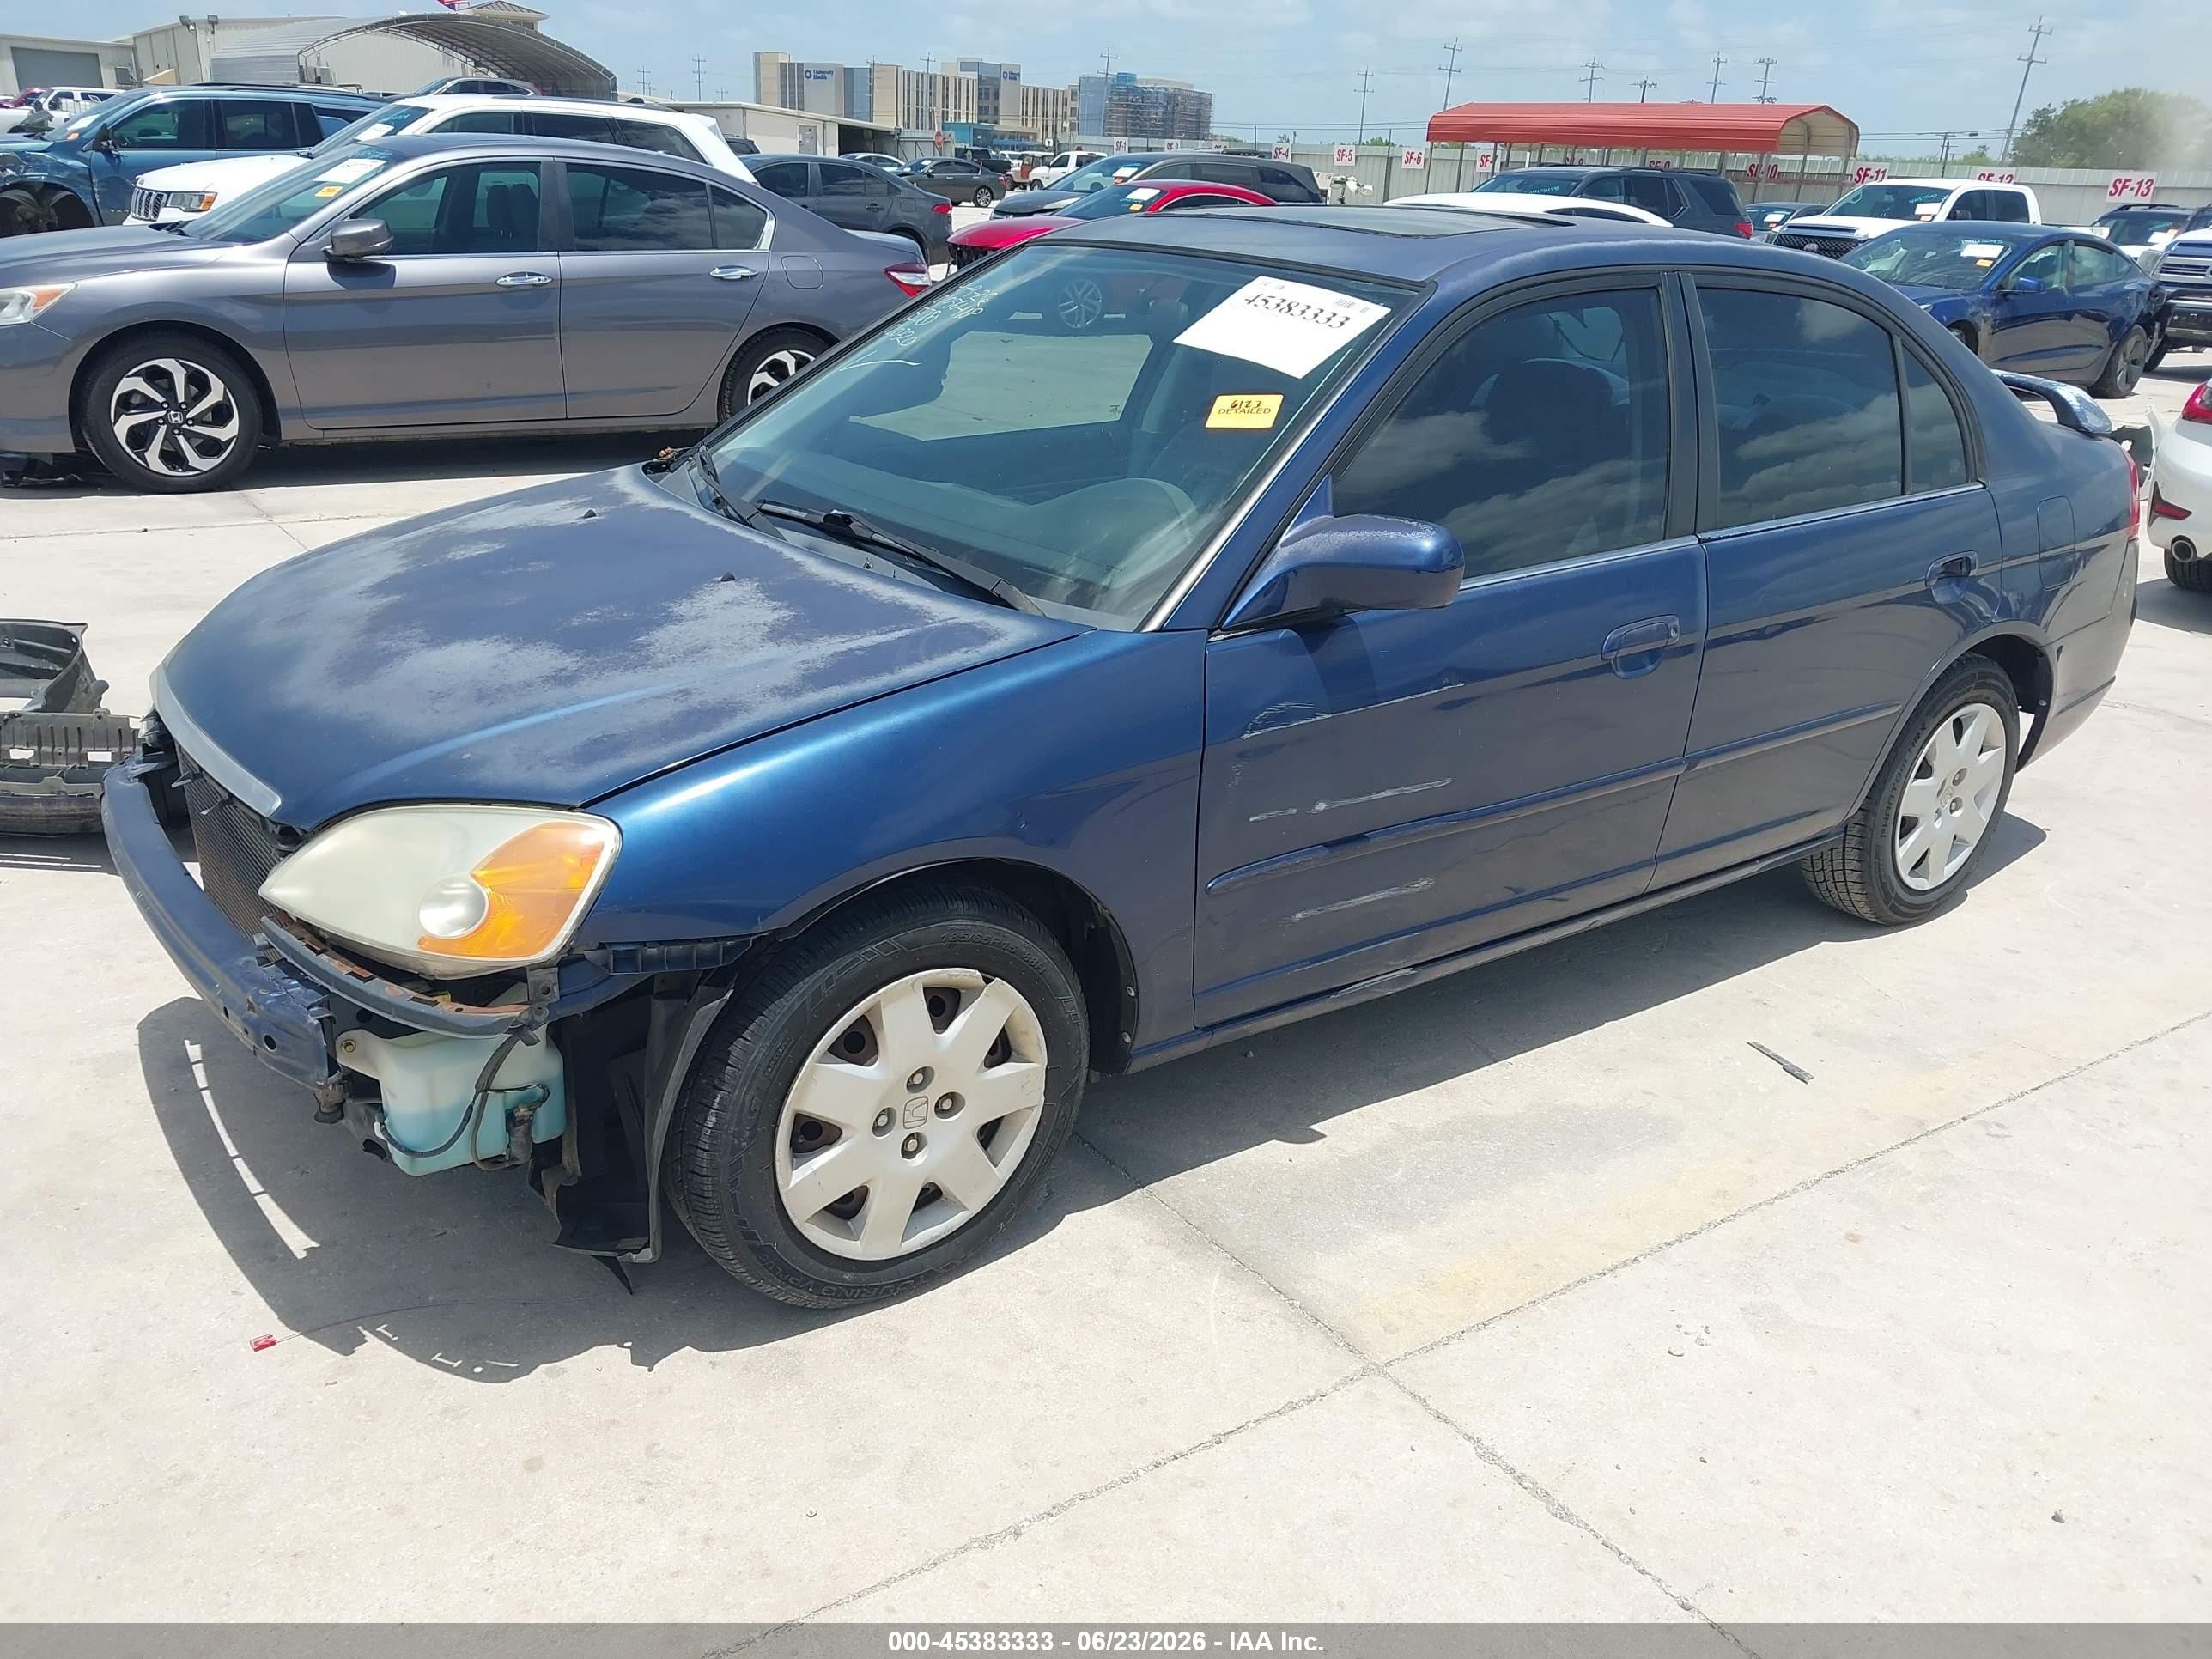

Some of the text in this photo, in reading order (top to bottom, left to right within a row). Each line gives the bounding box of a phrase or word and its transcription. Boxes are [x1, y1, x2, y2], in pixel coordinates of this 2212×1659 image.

[1115, 141, 1126, 151] SF-1
[1273, 147, 1289, 159] SF-4
[1336, 149, 1353, 161] SF-5
[1404, 151, 1423, 165] SF-6
[1854, 167, 1887, 184] SF-11
[2109, 178, 2154, 198] SF-13
[1244, 293, 1351, 329] 45383333
